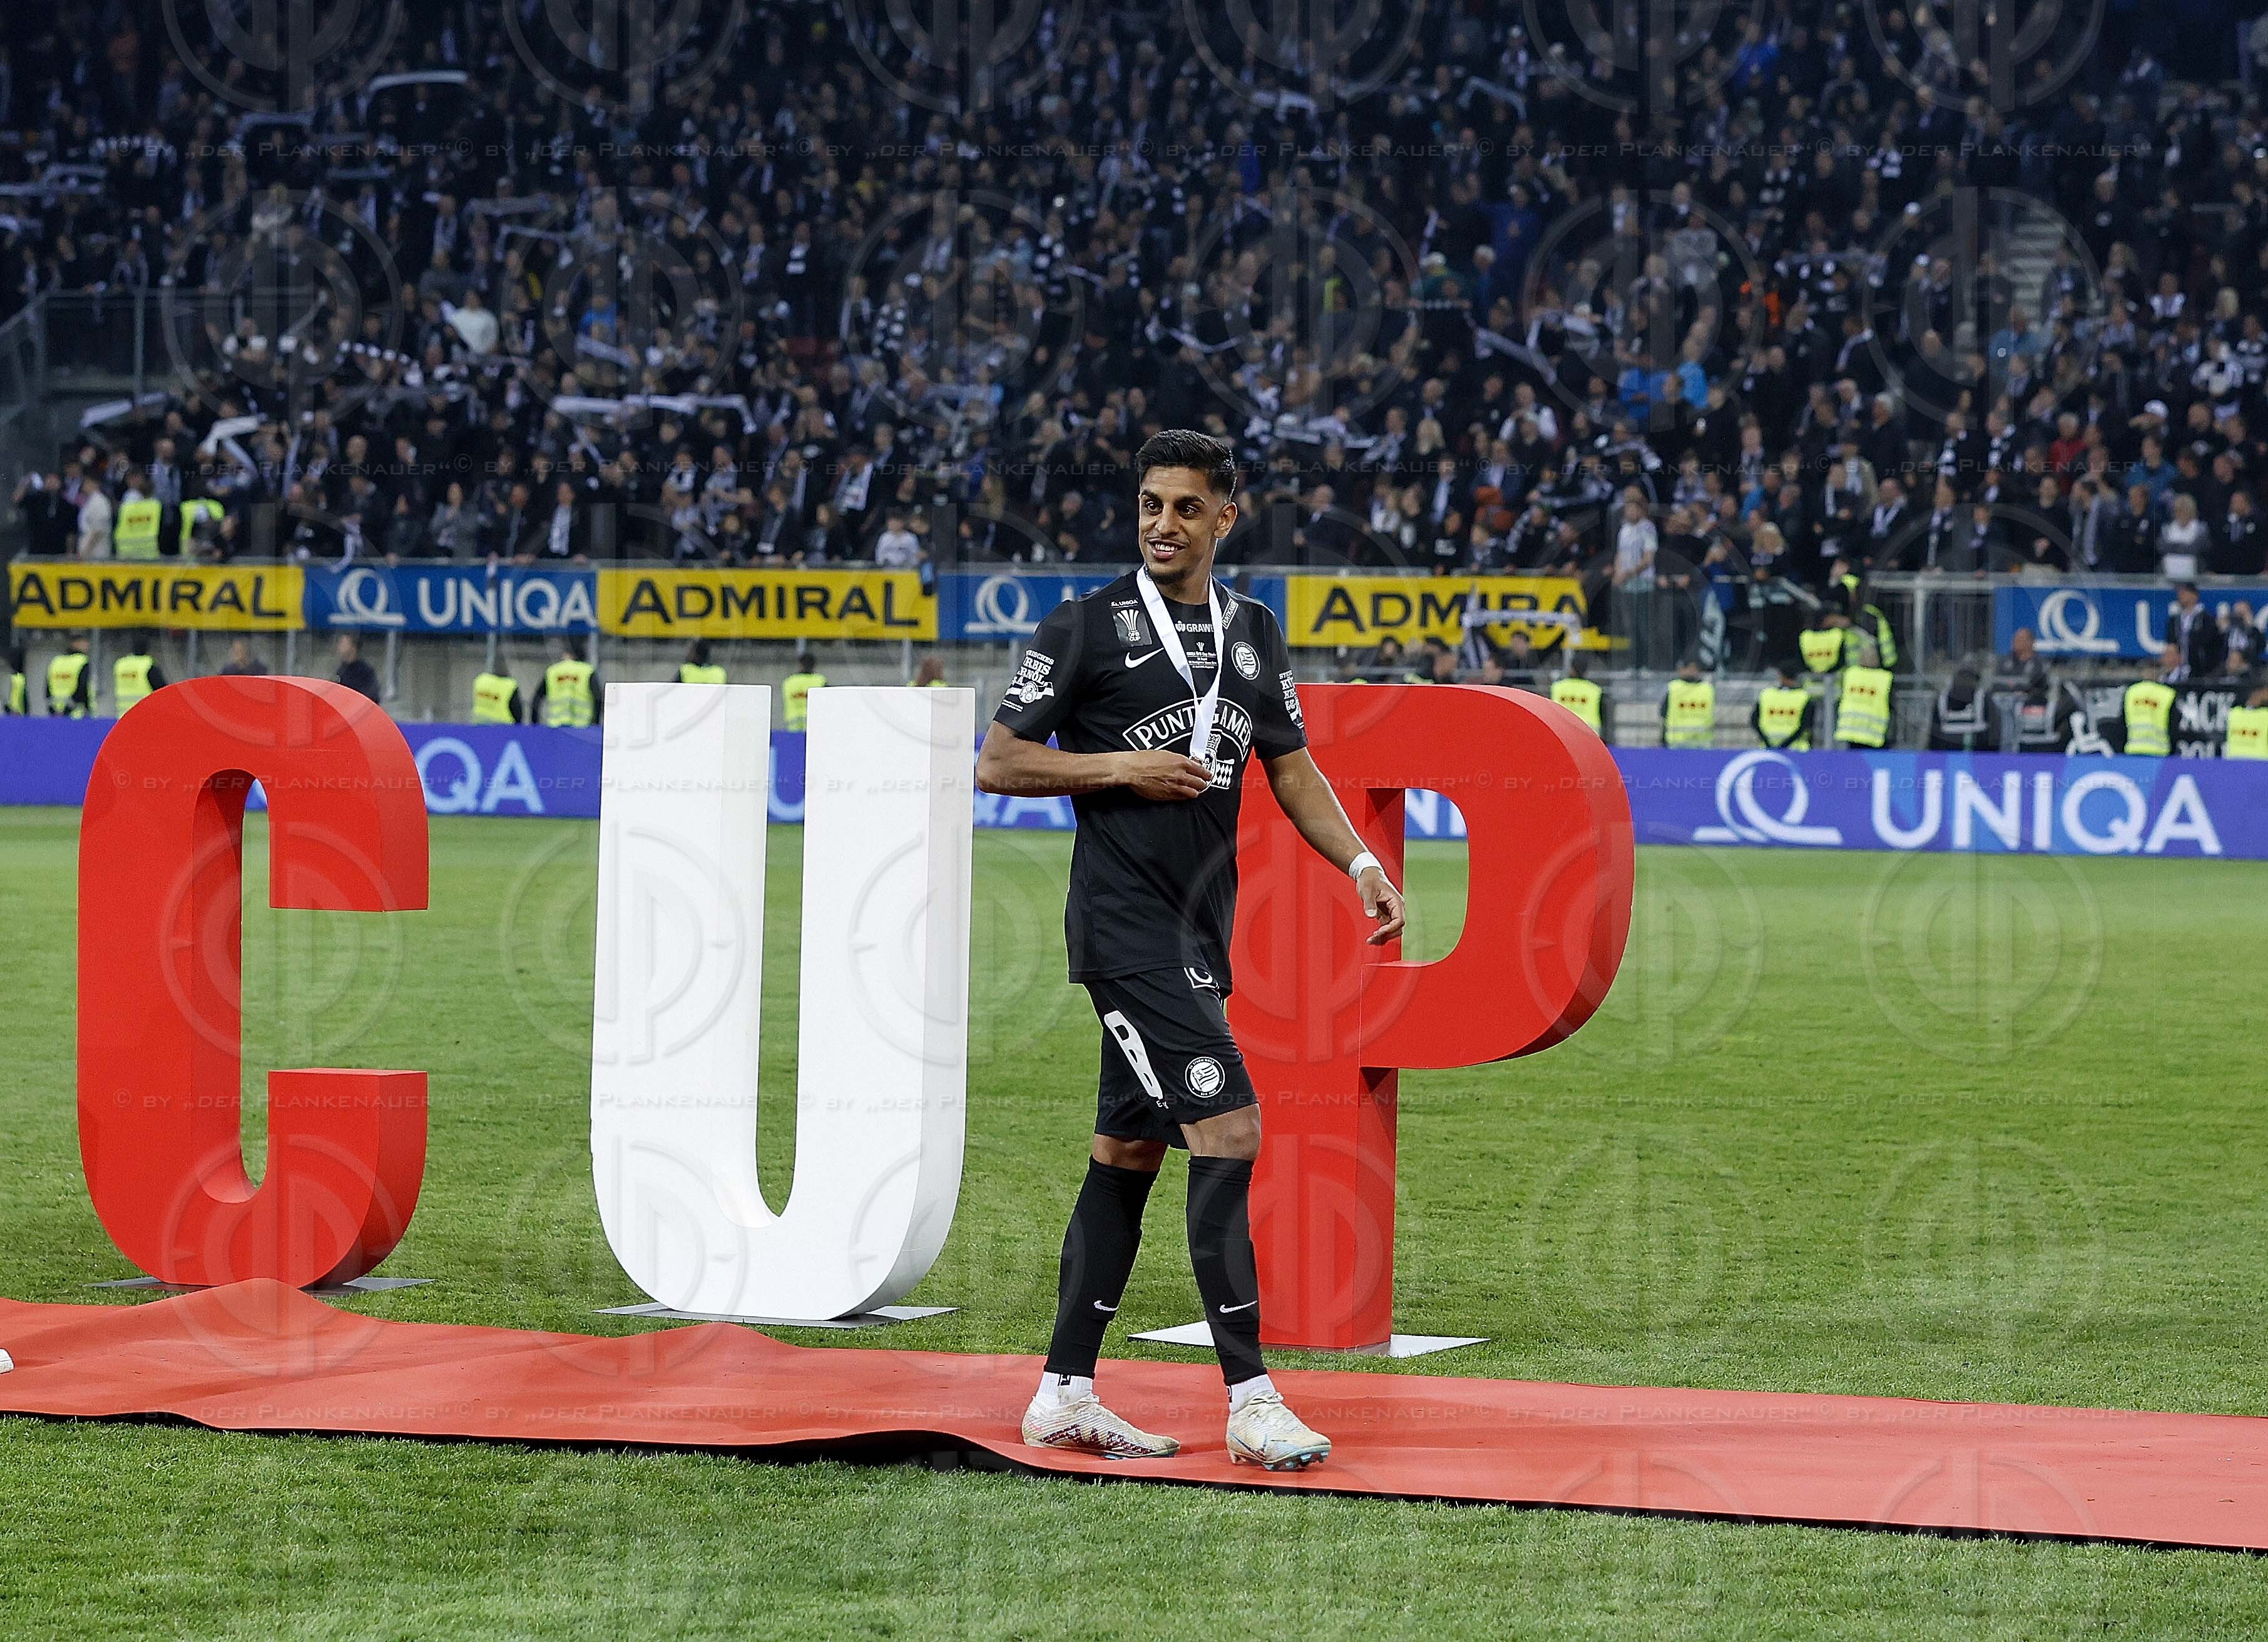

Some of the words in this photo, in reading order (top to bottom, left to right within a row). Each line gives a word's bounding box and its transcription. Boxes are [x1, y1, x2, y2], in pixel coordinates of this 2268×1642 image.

[14, 572, 288, 617] ADMIRAL
[417, 576, 598, 628] UNIQA
[620, 579, 919, 627] ADMIRAL
[1311, 586, 1586, 634] ADMIRA
[1871, 767, 2223, 855] UNIQA
